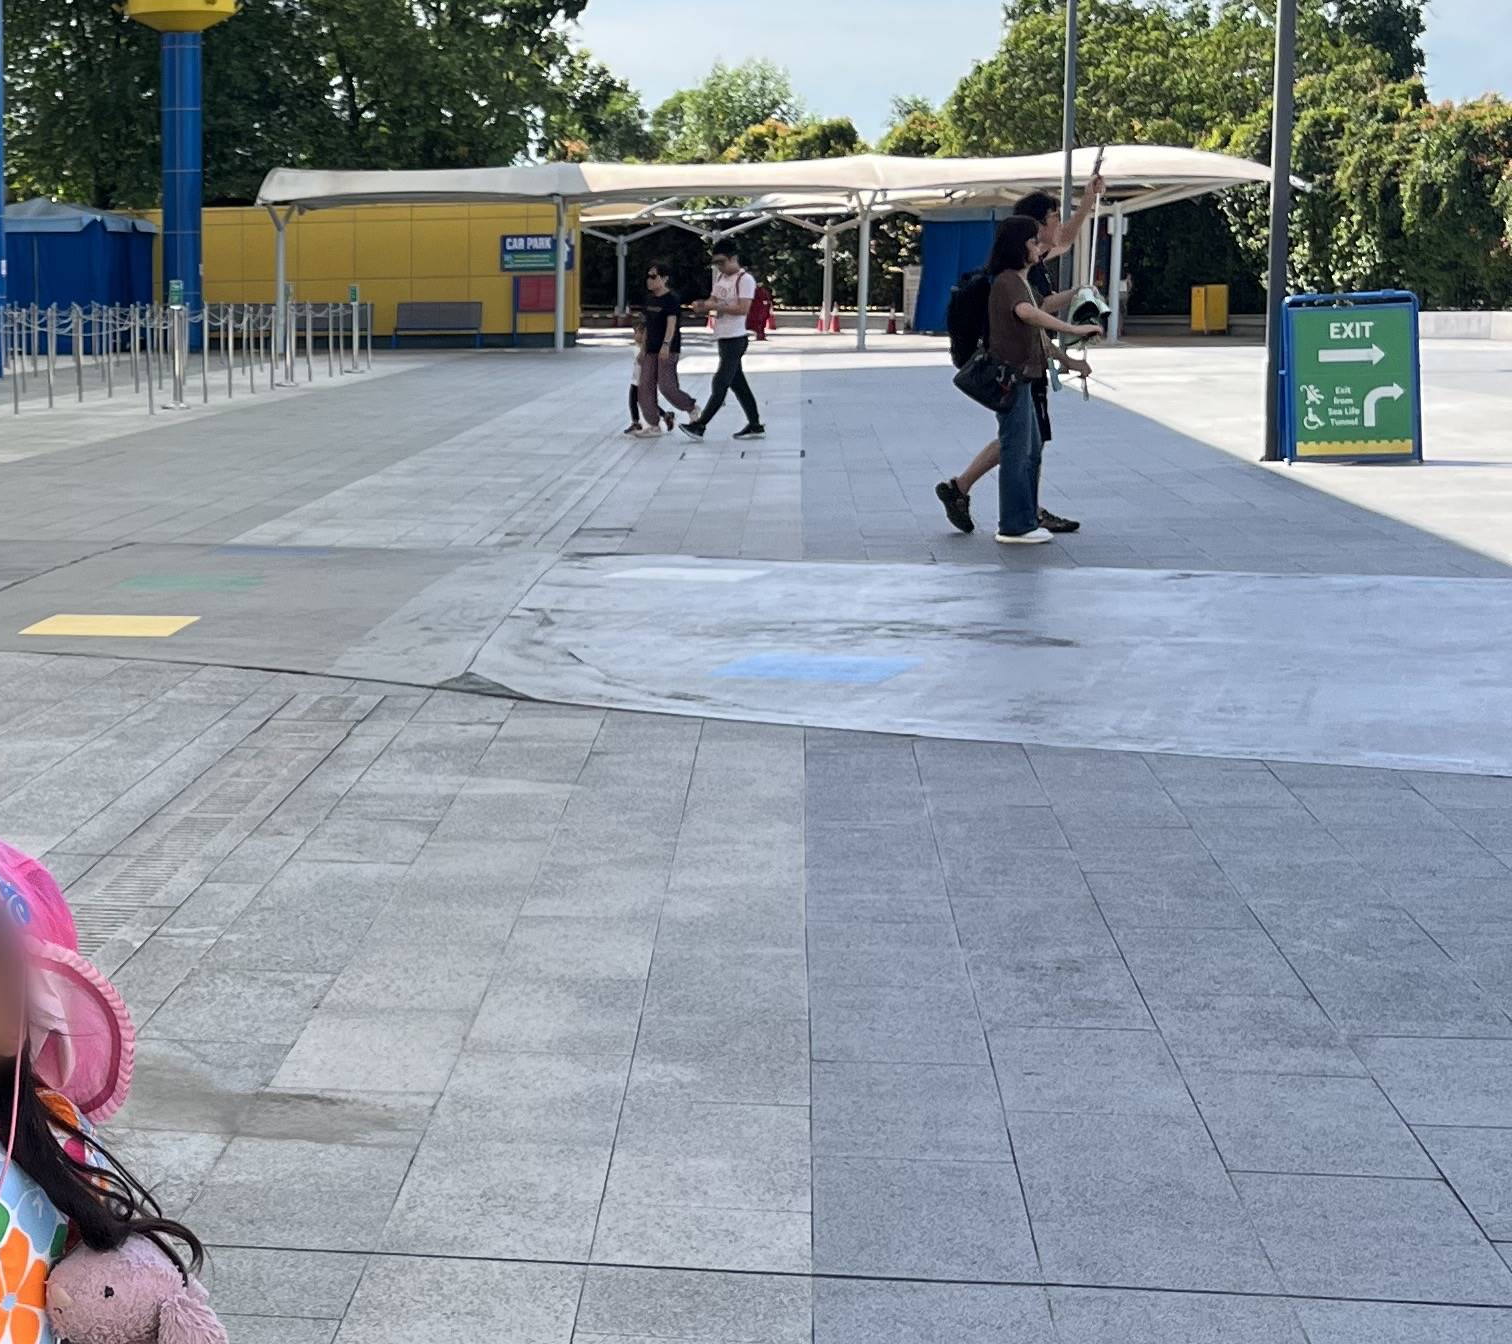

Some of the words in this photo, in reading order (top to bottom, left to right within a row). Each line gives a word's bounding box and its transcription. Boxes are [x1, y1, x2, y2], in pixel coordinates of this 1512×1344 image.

[505, 237, 525, 250] CAR
[527, 237, 552, 250] PARK
[1329, 321, 1374, 339] EXIT
[1335, 386, 1351, 394] Exit
[1333, 396, 1354, 405] from
[1344, 407, 1360, 416] Life
[1330, 417, 1358, 426] Tunnel
